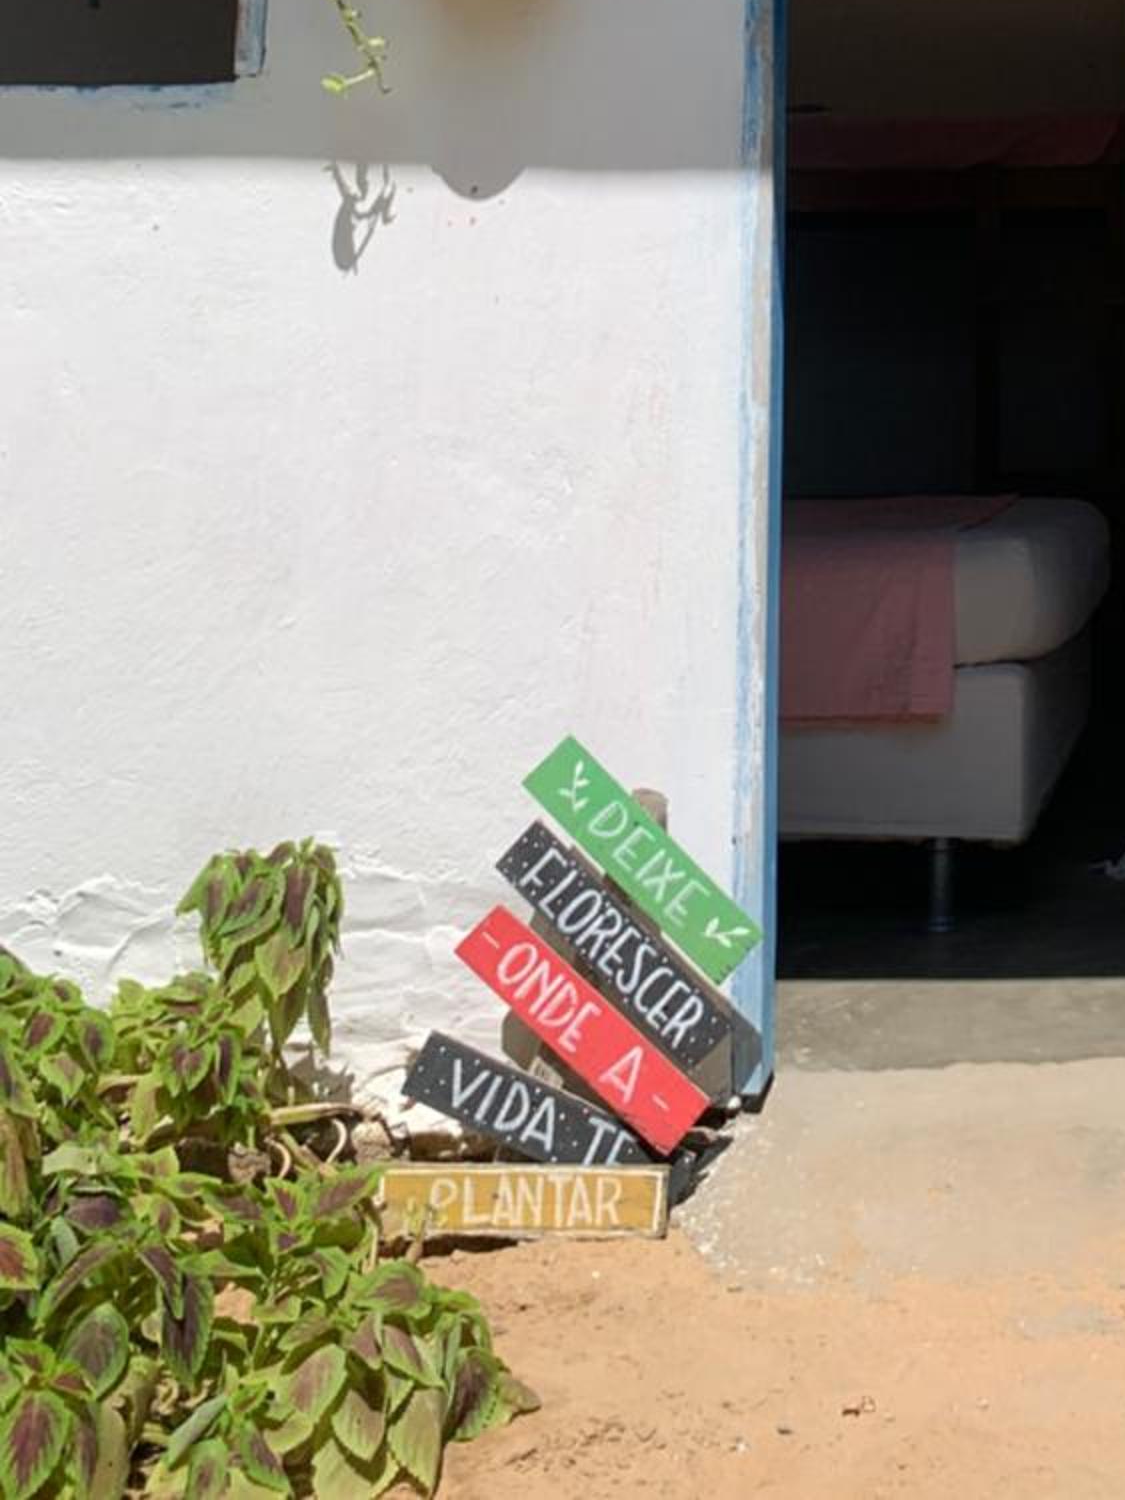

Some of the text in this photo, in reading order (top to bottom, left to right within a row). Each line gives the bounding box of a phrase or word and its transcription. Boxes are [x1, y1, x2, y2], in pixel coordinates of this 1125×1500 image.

[588, 800, 711, 928] DEIXE
[519, 847, 704, 1050] FLORESCER
[496, 942, 644, 1105] ONDE A
[452, 1058, 556, 1153] VIDA
[430, 1171, 623, 1228] PLANTAR
